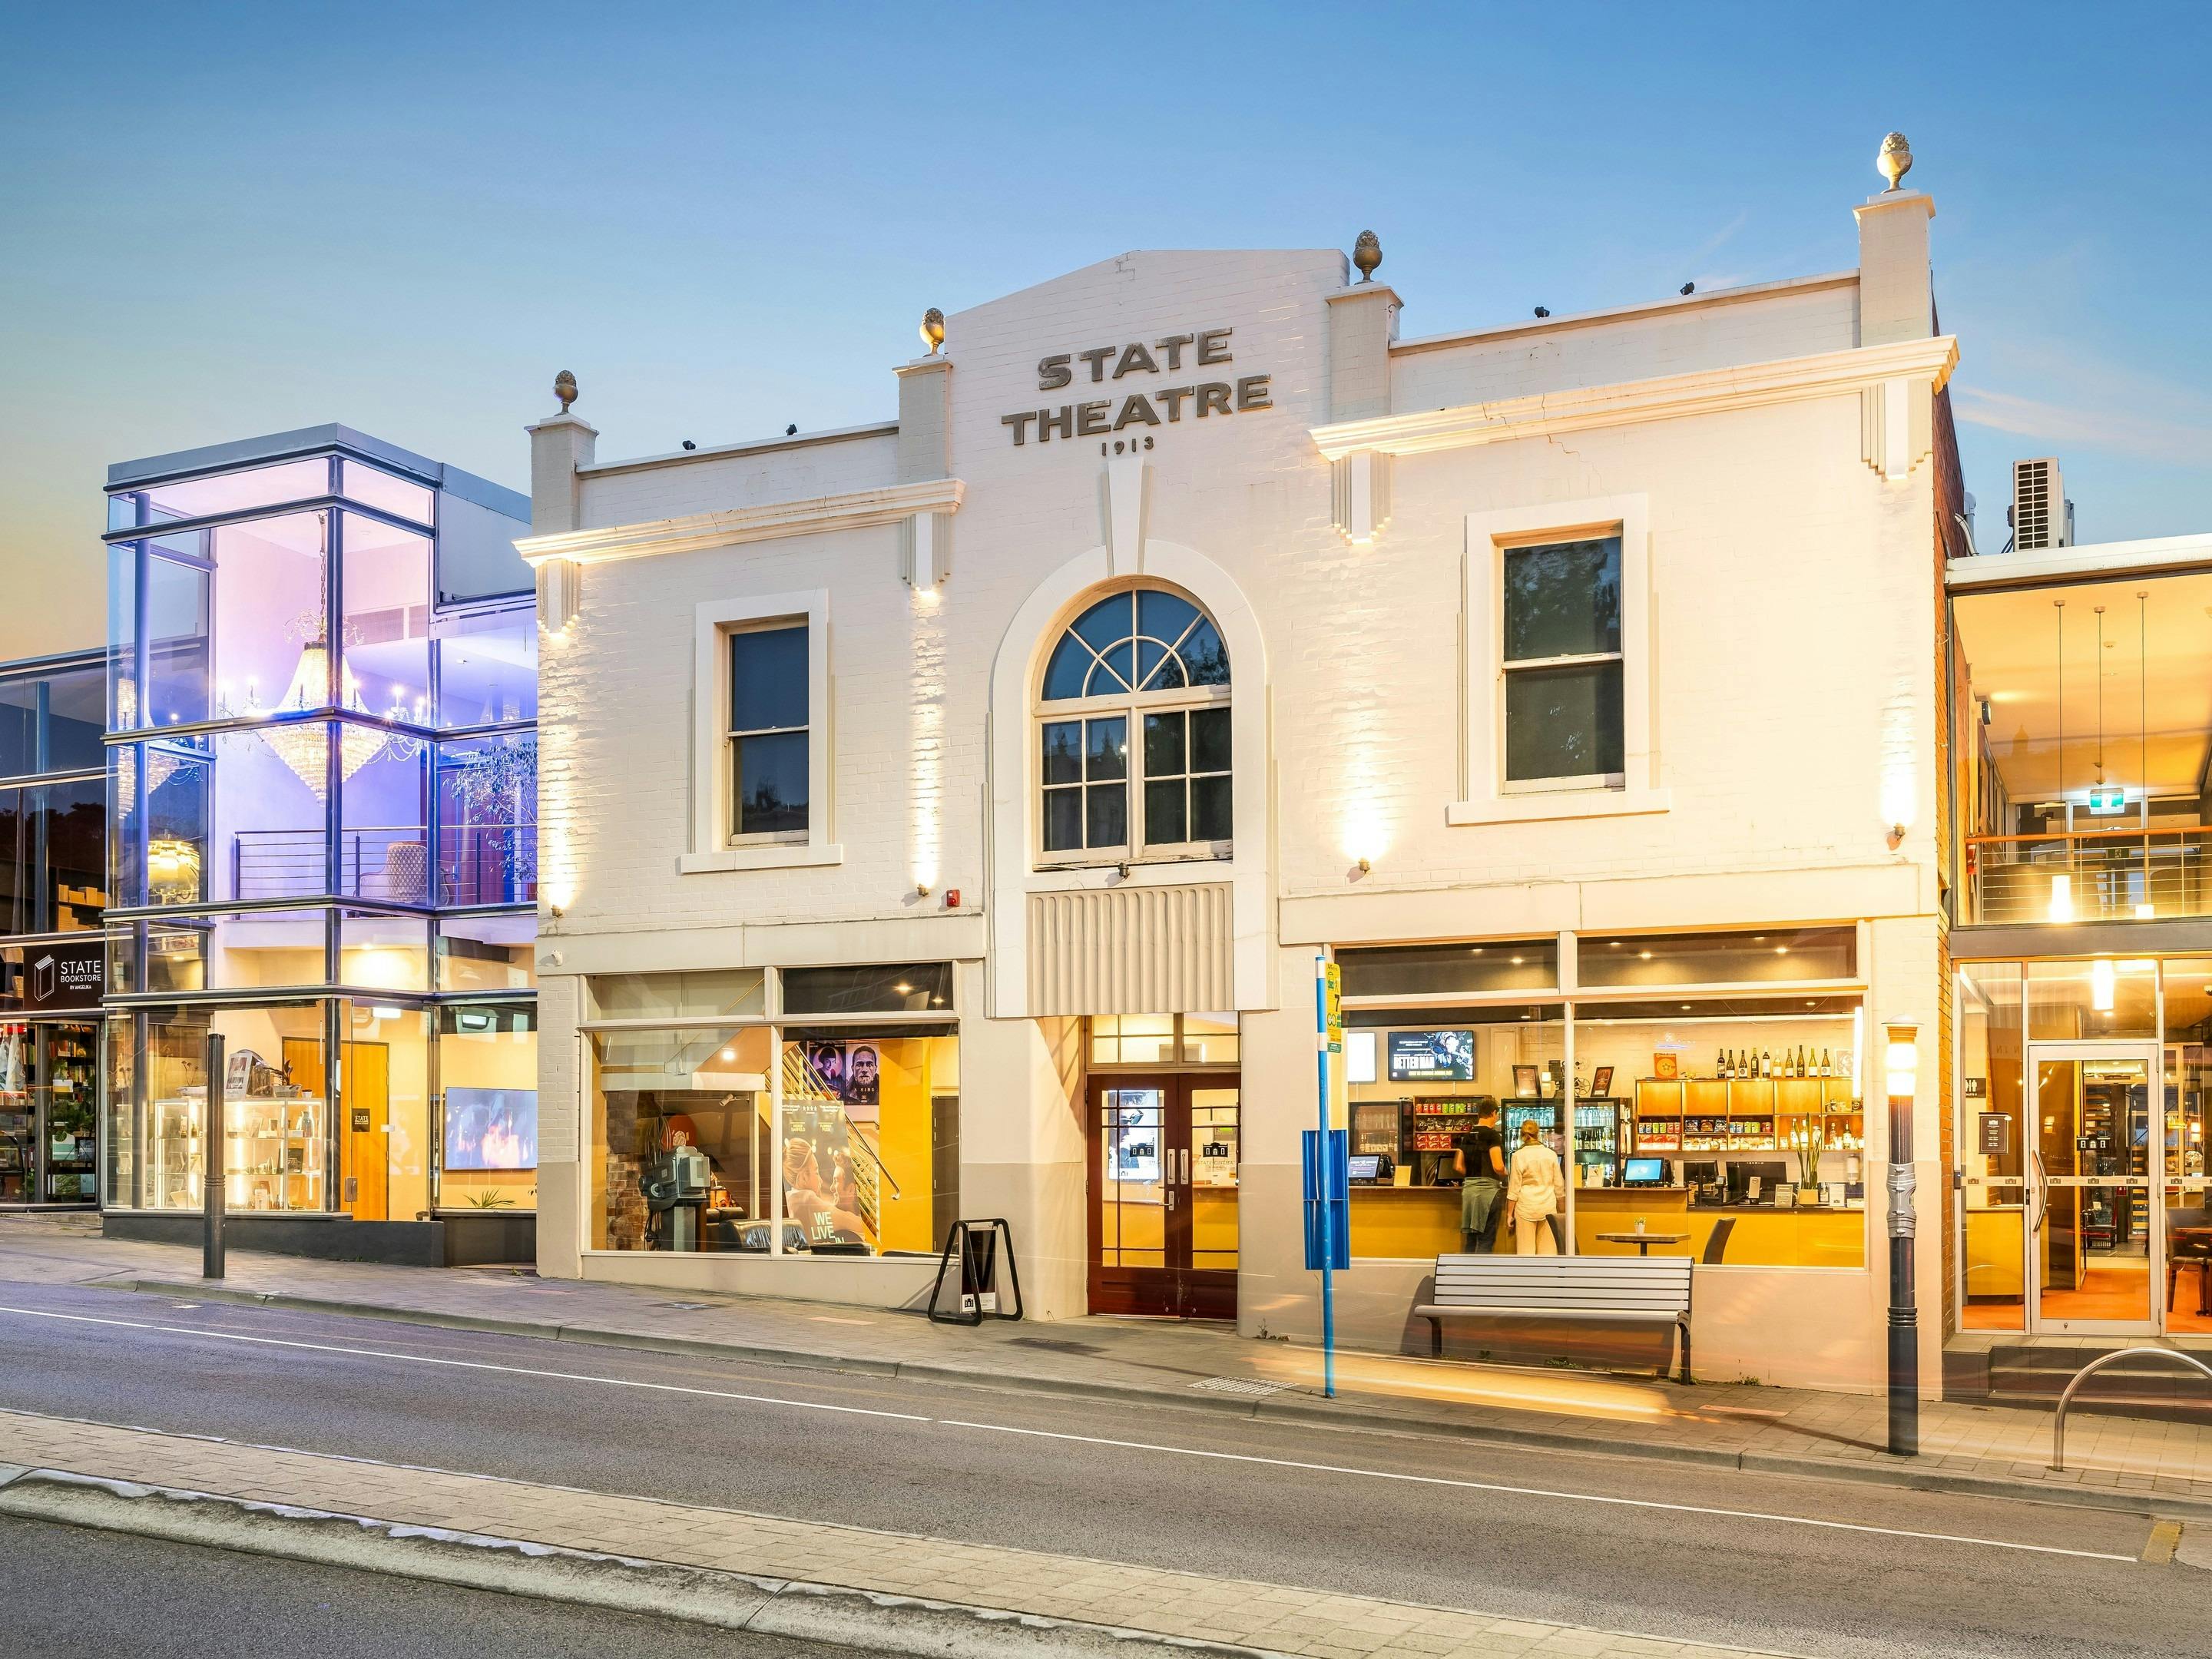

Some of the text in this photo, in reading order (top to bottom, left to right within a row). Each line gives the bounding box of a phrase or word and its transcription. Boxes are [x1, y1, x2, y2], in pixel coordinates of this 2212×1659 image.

[1038, 327, 1233, 390] STATE
[1001, 374, 1273, 446] THEATRE
[1101, 435, 1154, 456] 1913
[61, 960, 101, 975] STATE
[60, 974, 101, 983] BOOKSTORE
[1334, 994, 1340, 1012] 7
[813, 1211, 833, 1226] WE
[810, 1225, 836, 1240] LIVE
